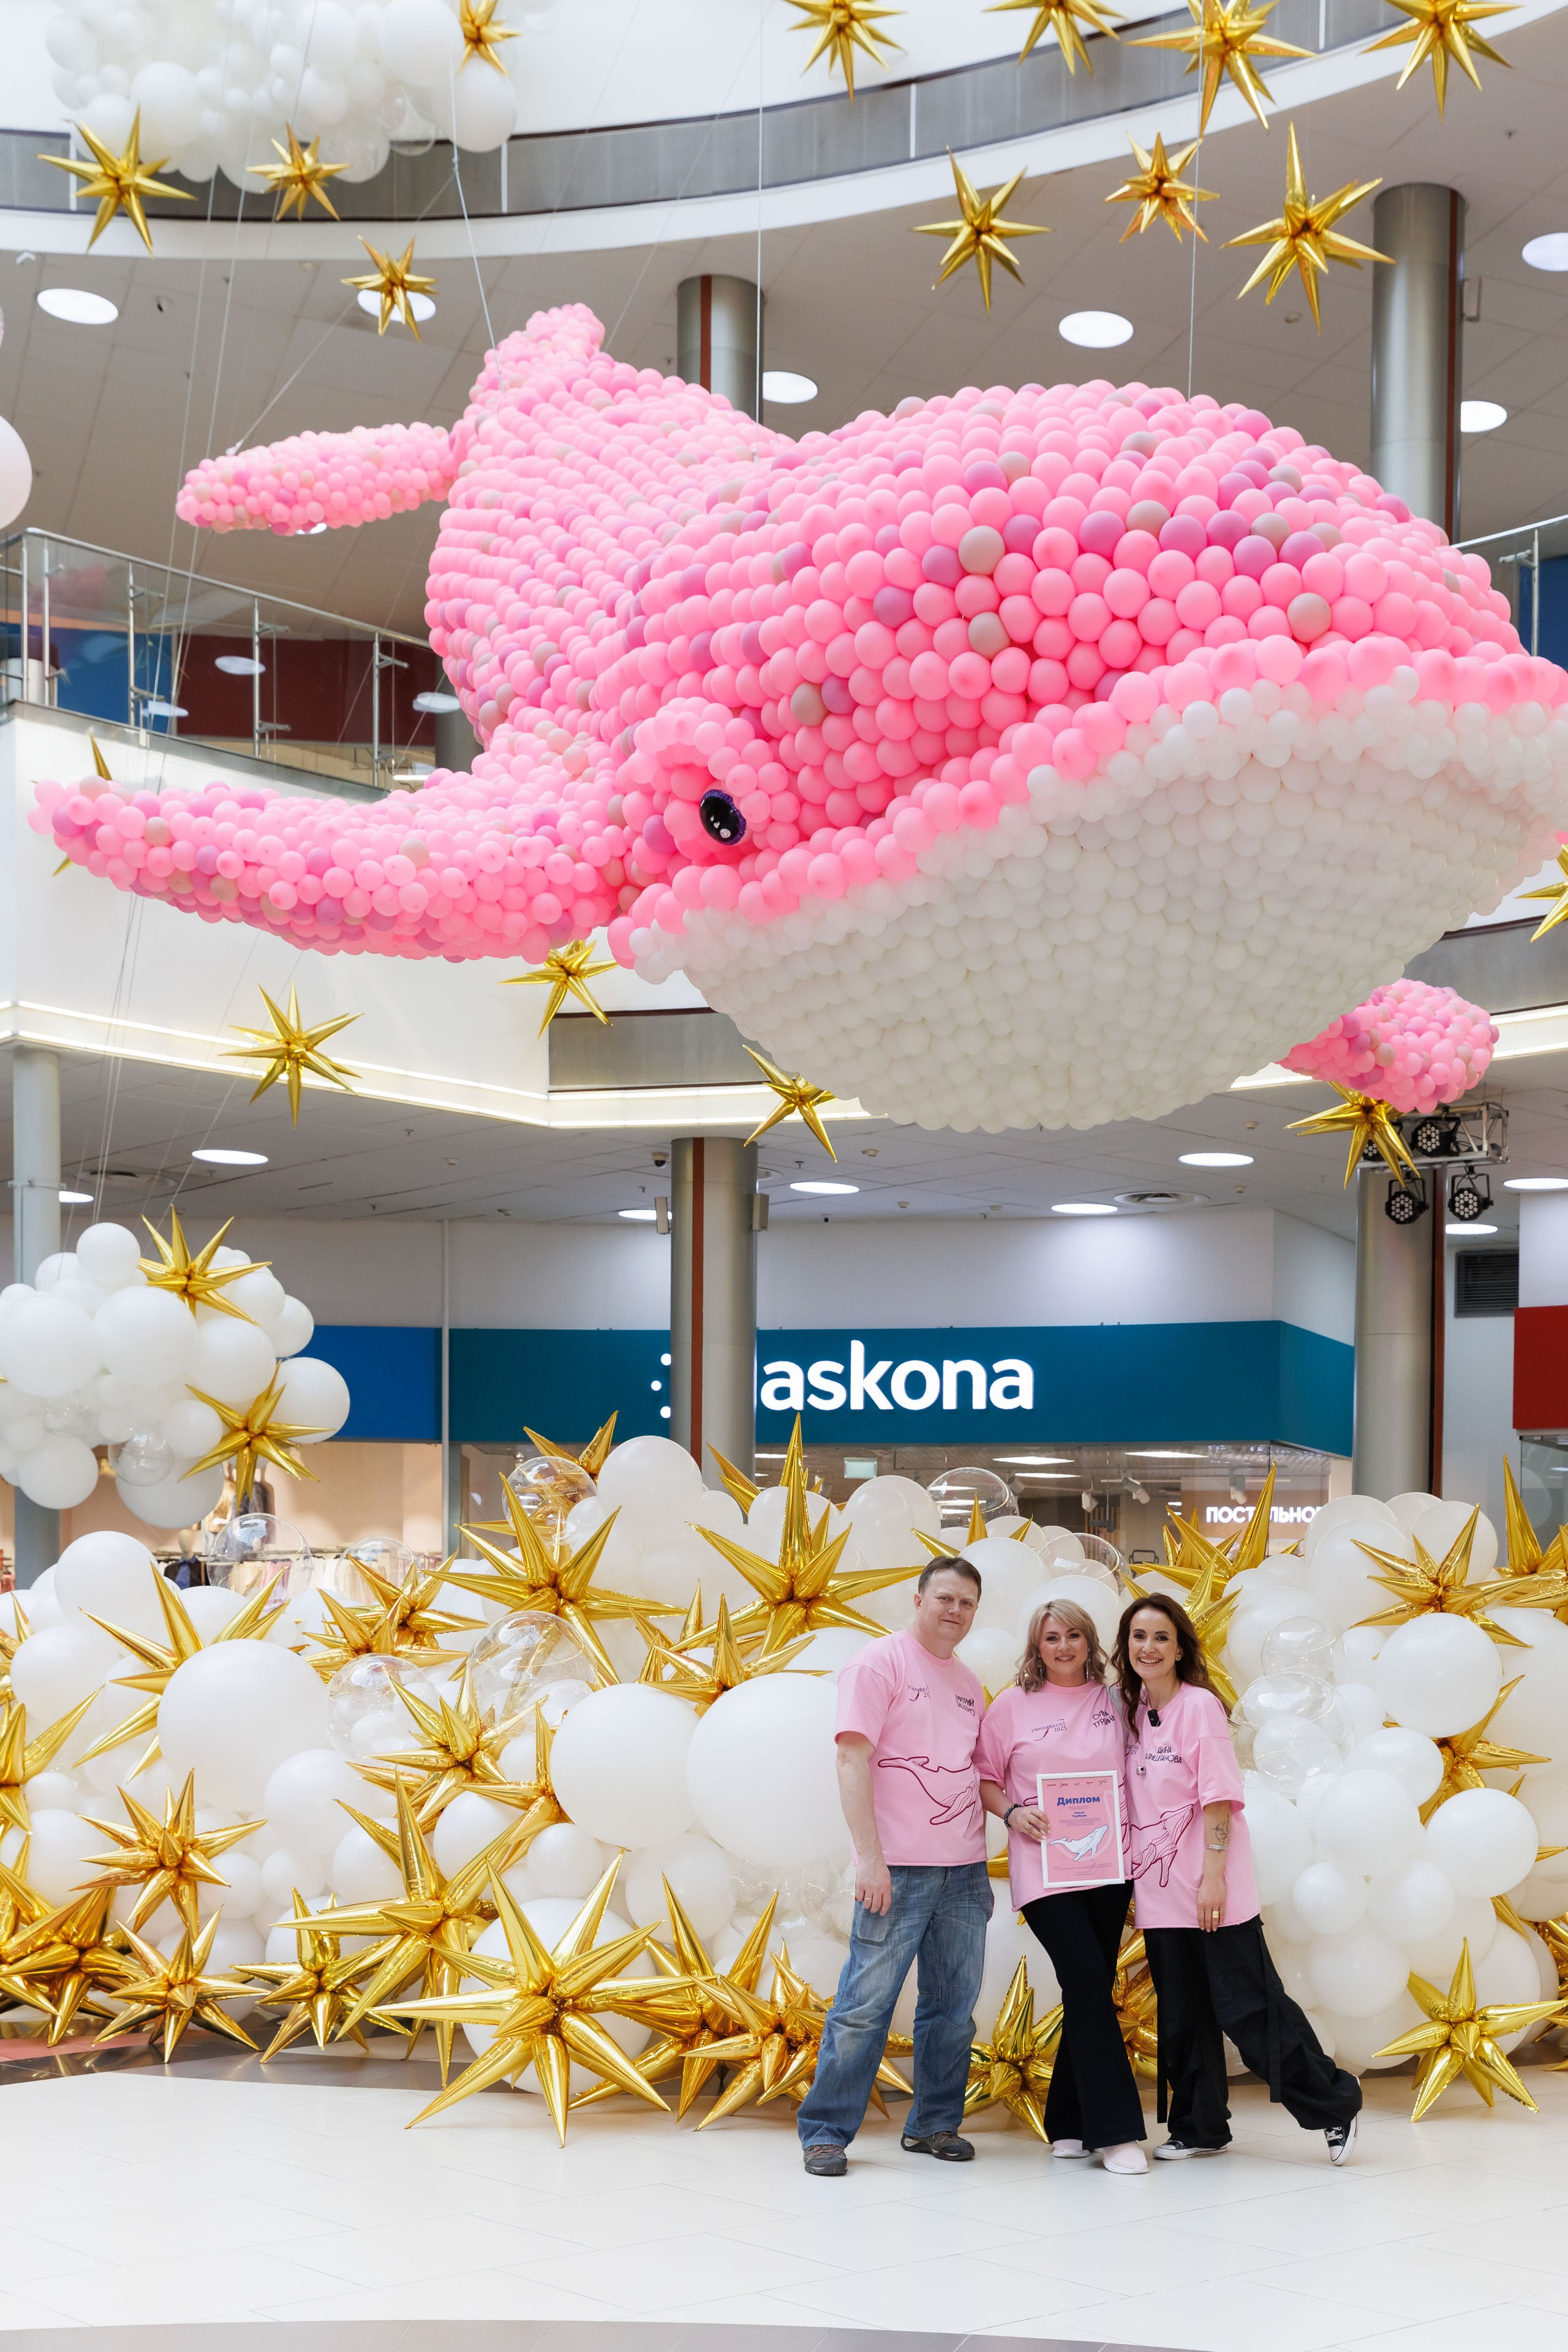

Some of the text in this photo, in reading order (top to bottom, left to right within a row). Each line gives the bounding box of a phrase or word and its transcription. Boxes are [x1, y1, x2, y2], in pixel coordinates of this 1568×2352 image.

[760, 1340, 1035, 1411] askona
[1206, 1506, 1322, 1524] ПОСТЛЬНО
[1093, 1709, 1110, 1720] ОЛЬА
[1092, 1714, 1115, 1728] ТУРИНА
[1157, 1746, 1172, 1754] ДИНА
[1057, 1796, 1101, 1806] Диплом
